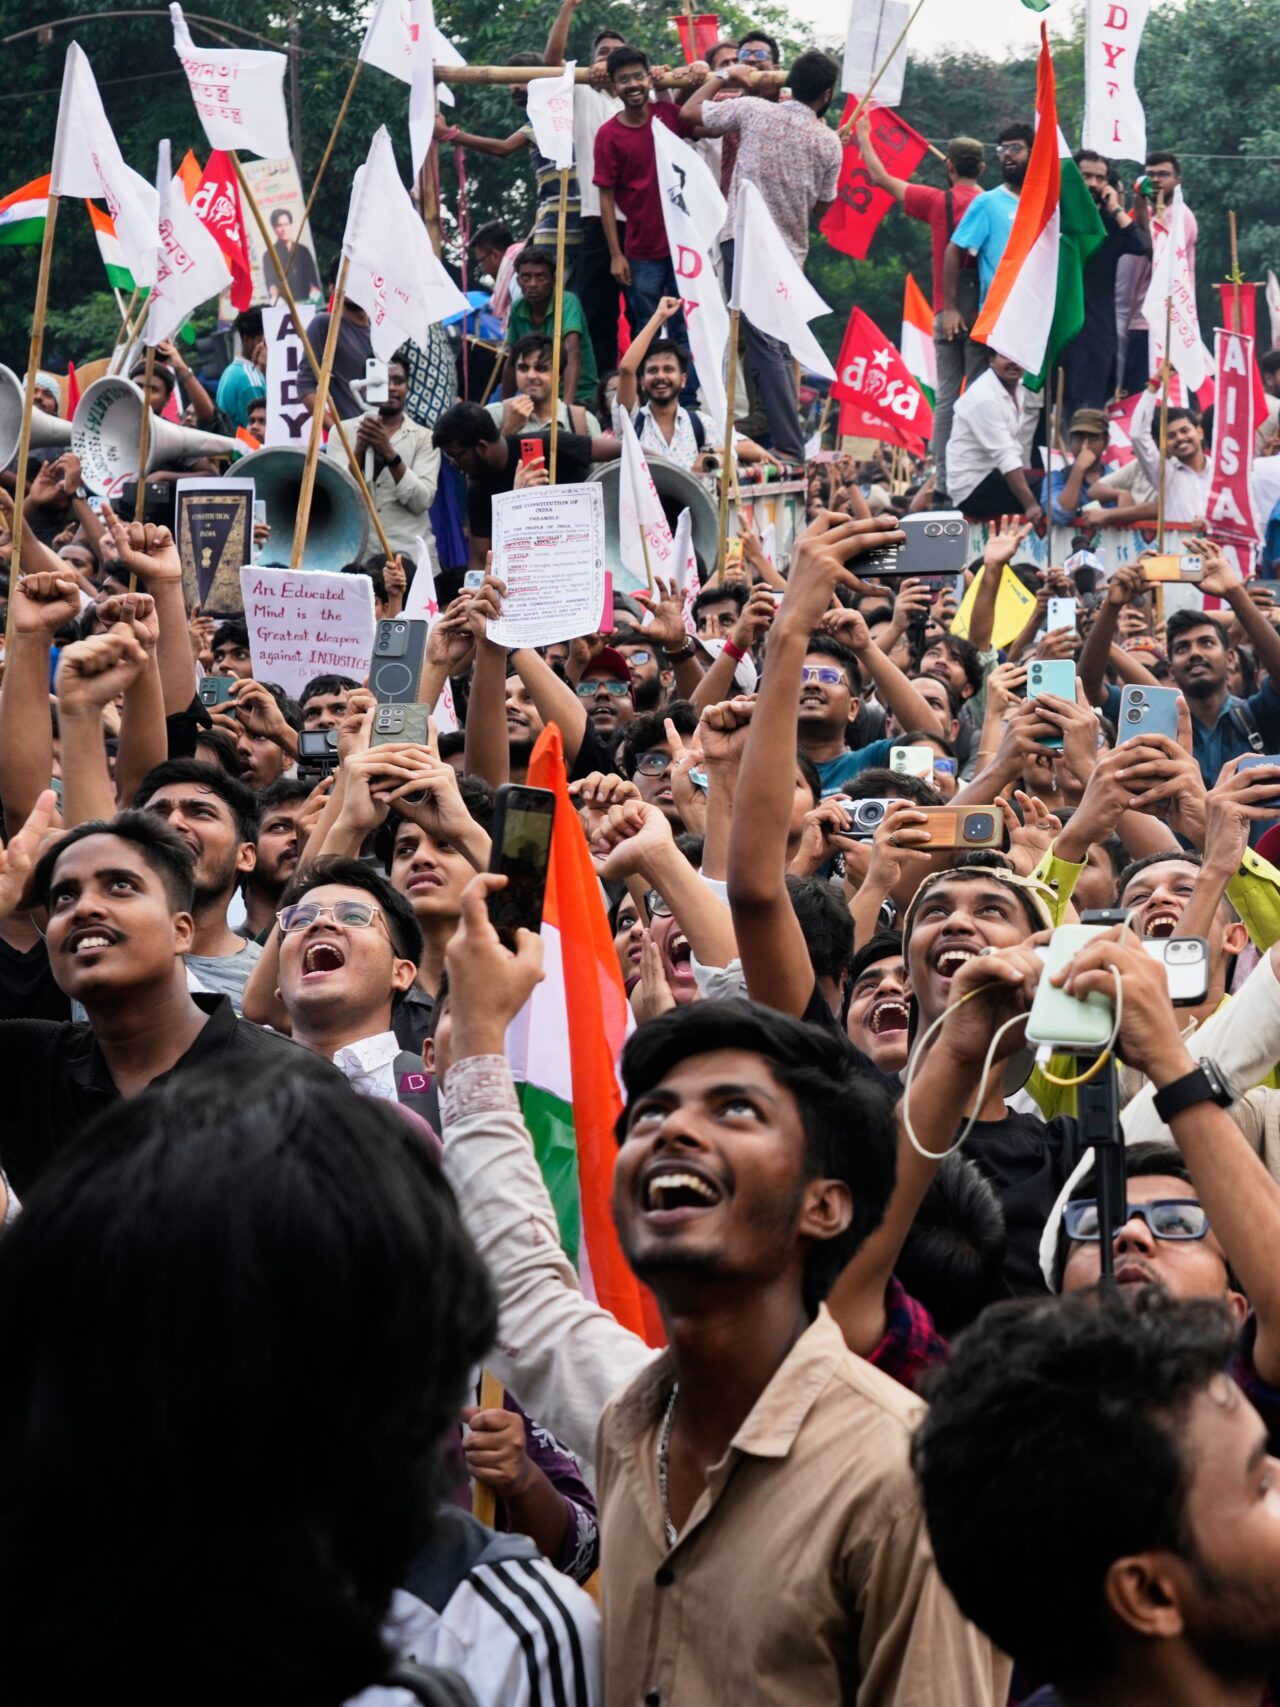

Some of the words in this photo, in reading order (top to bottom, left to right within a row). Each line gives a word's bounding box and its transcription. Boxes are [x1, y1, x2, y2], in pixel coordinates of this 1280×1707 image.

[1211, 333, 1248, 526] AISA
[524, 500, 569, 509] CONSTITUTION
[191, 512, 231, 521] CONSTITUTION
[200, 530, 217, 538] INDIA
[252, 579, 276, 597] An
[281, 582, 346, 601] Educated
[254, 604, 285, 618] Mind
[297, 607, 307, 619] is
[320, 609, 342, 621] the
[257, 626, 309, 642] Greatest
[316, 631, 360, 648] Weapon
[259, 649, 303, 666] against
[309, 650, 370, 671] INJUSTICE
